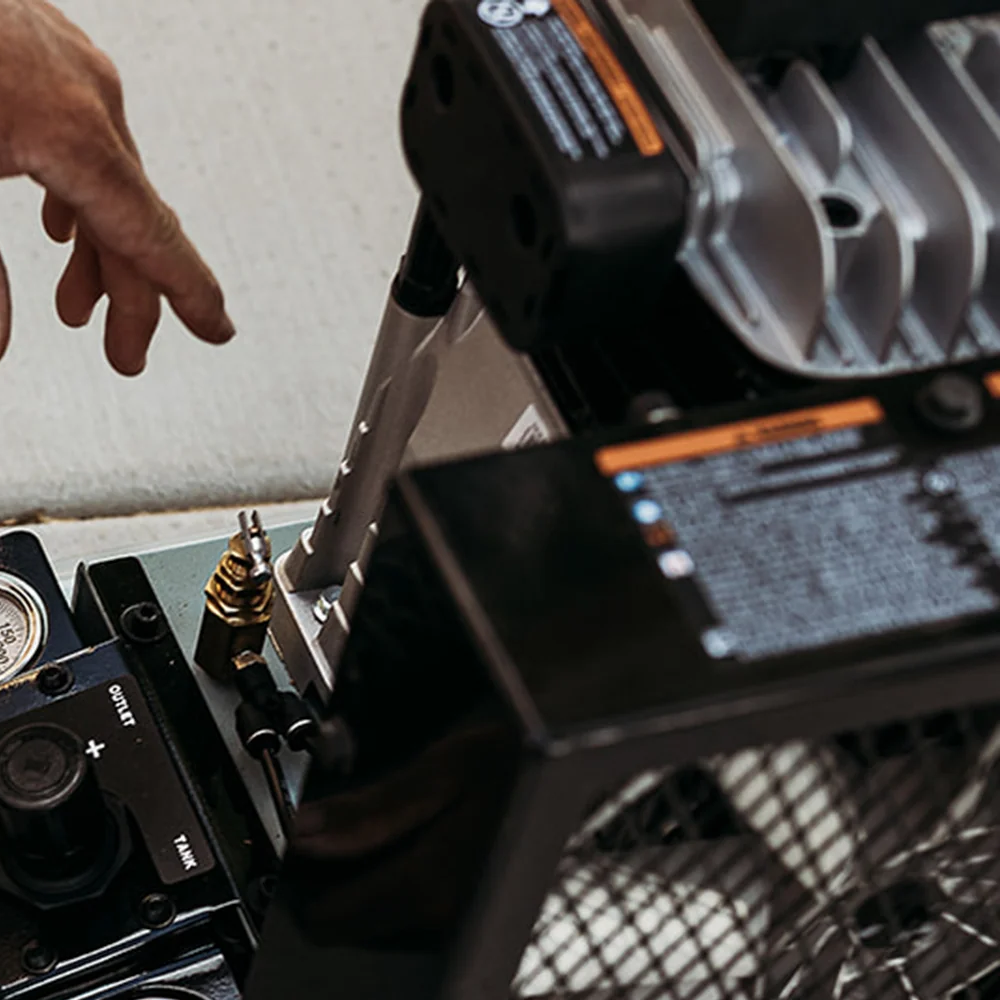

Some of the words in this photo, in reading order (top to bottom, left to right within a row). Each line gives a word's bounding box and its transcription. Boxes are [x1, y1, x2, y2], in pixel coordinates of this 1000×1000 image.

[0, 623, 17, 645] 150
[109, 684, 135, 728] OUTLET
[173, 834, 198, 871] TANK
